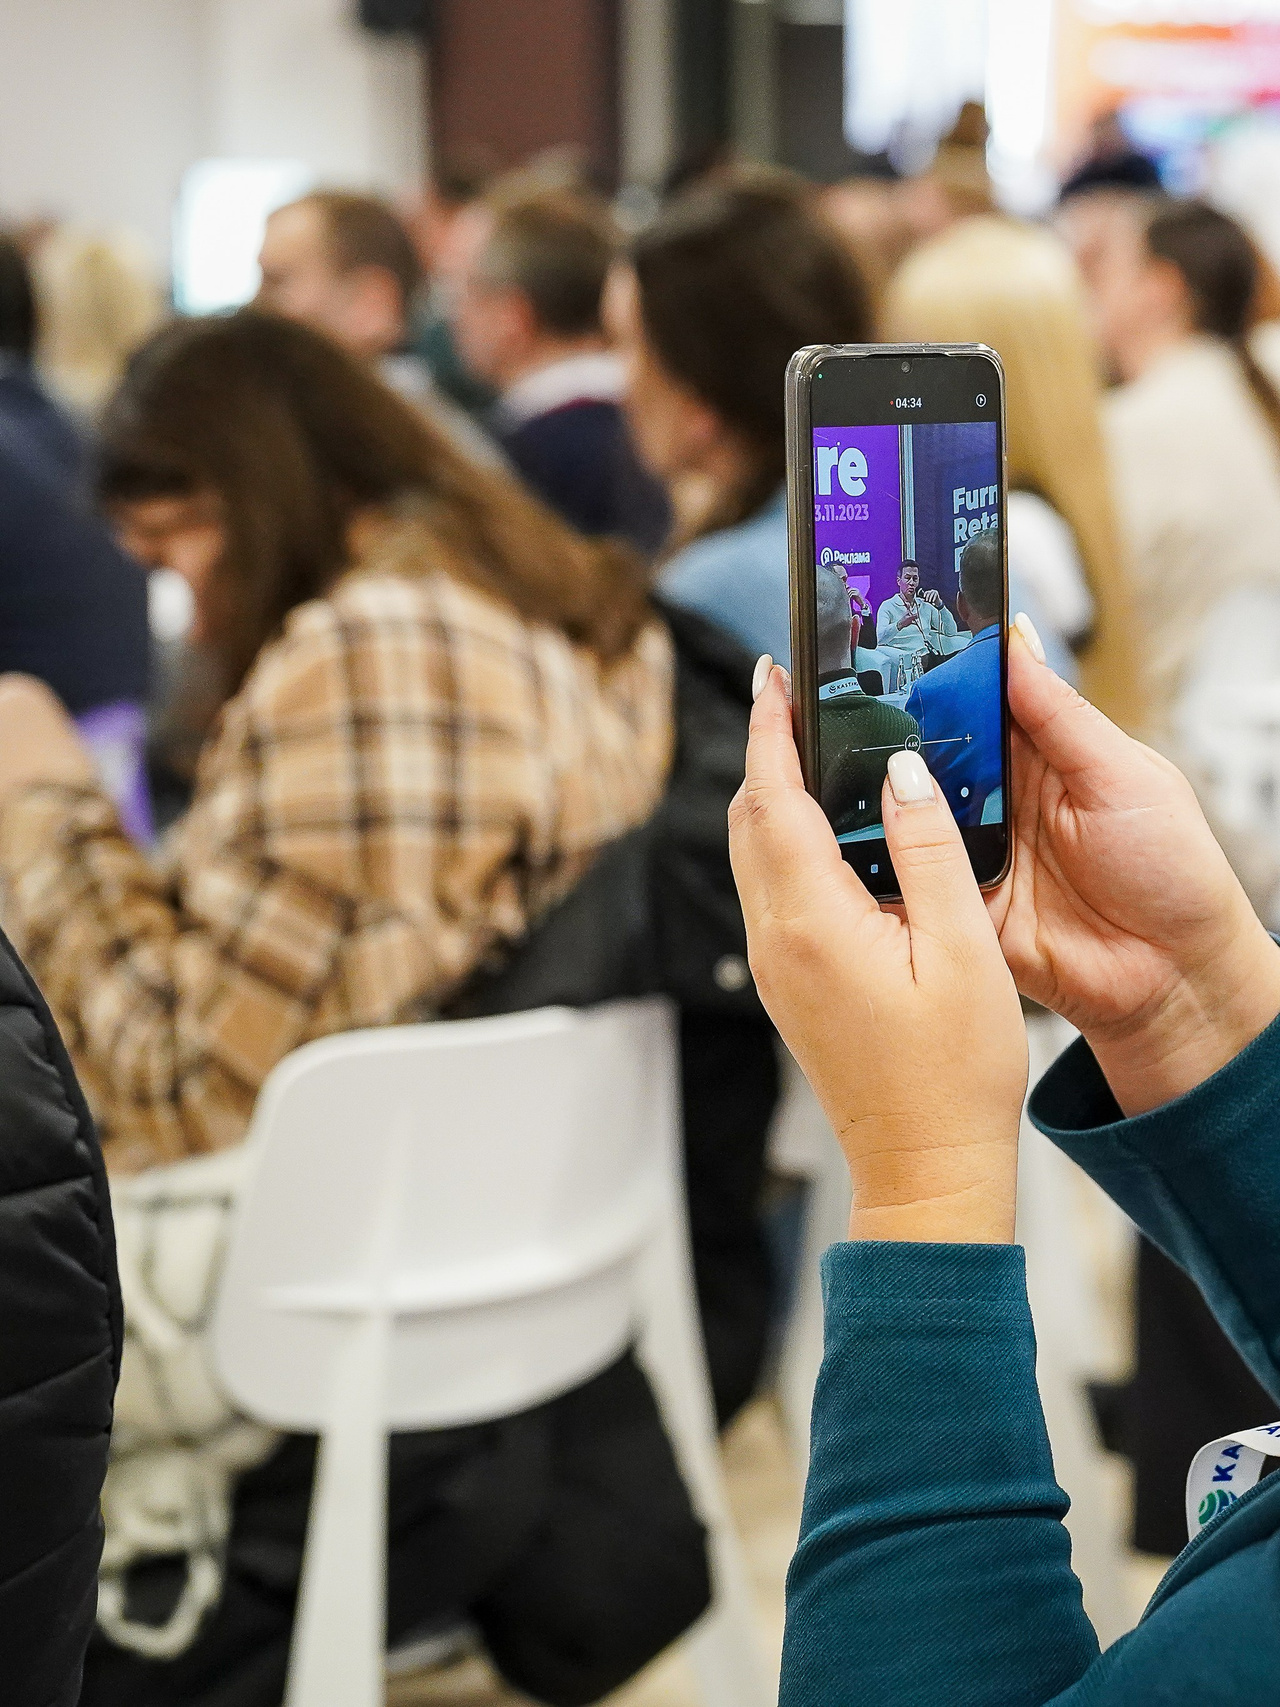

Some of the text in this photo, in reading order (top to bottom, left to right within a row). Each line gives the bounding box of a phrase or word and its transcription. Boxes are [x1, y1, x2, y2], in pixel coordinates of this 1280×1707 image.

[895, 397, 922, 409] 04:34
[813, 446, 869, 497] re
[834, 550, 870, 565] Реклама
